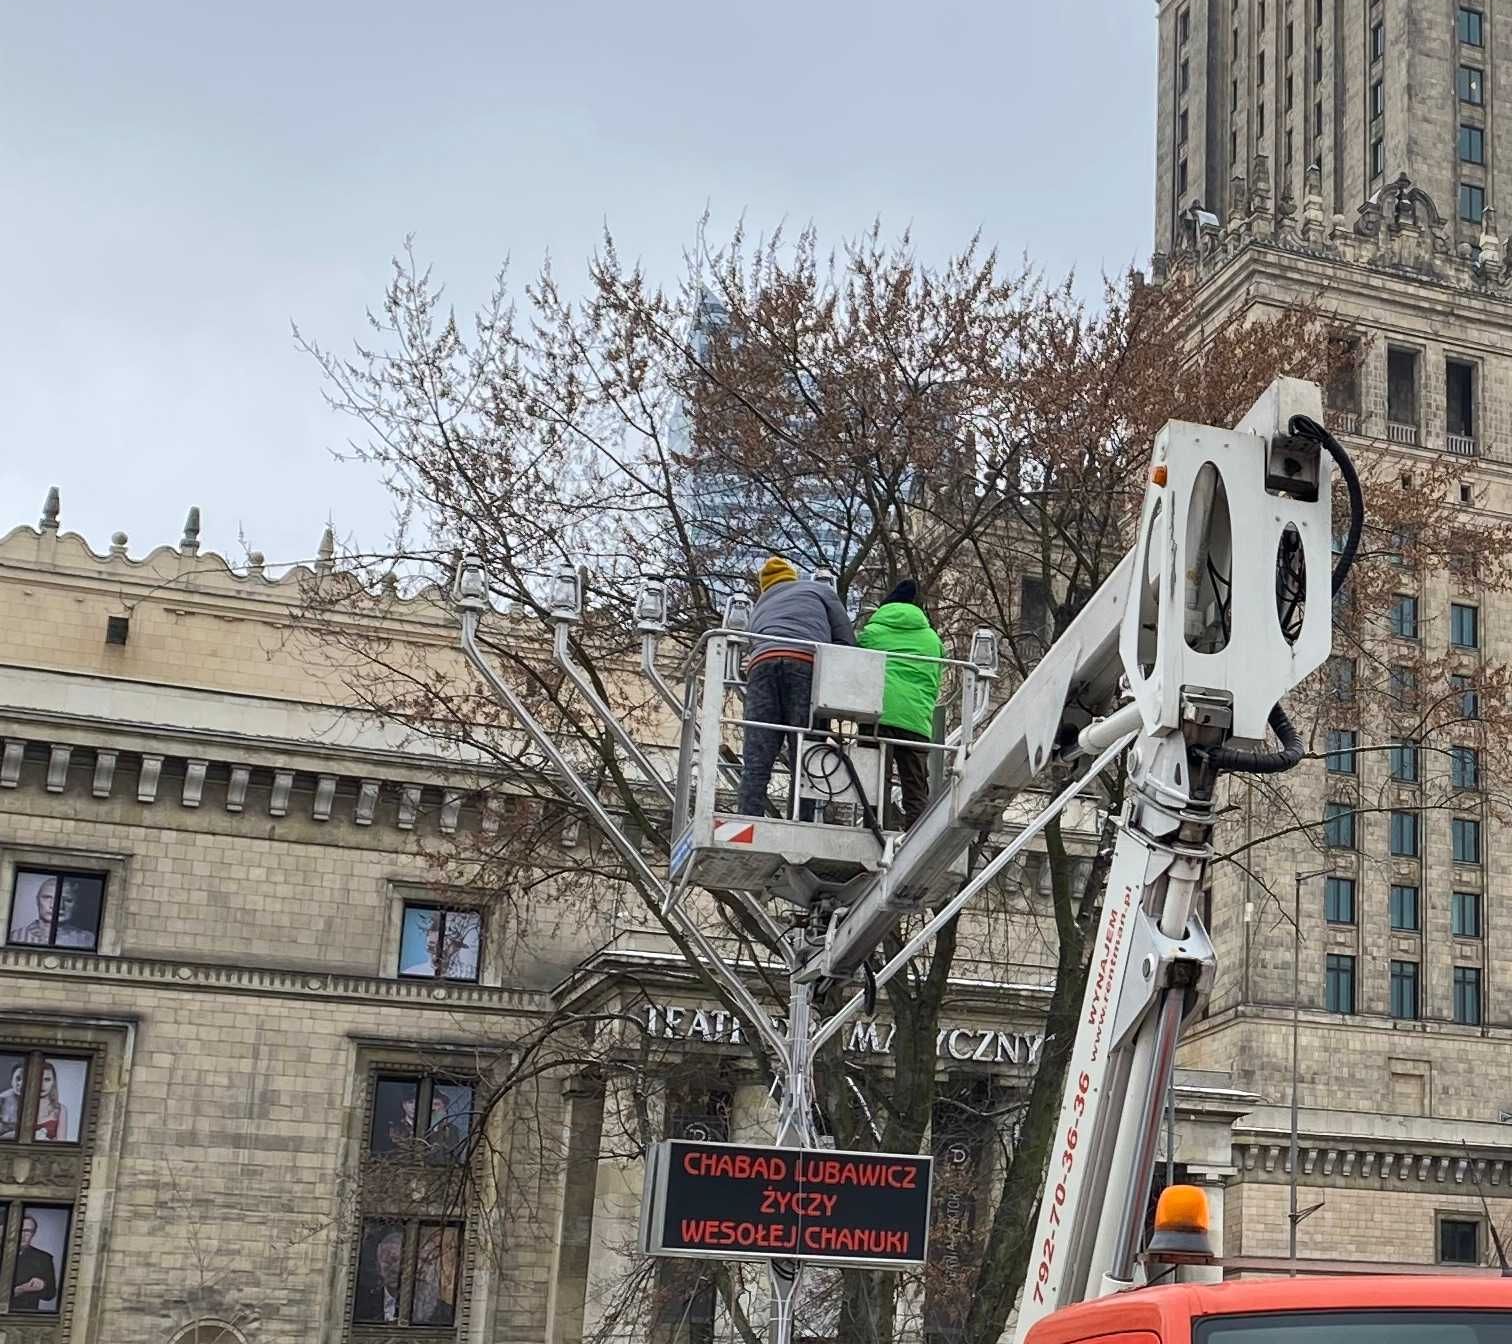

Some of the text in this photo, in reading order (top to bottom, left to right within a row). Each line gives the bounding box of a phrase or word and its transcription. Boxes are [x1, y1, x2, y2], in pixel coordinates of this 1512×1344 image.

[1088, 909, 1118, 1025] WYNAJEM
[1091, 885, 1132, 1062] www.rentman.pl
[683, 1152, 918, 1189] CHABAD LUBAWICZ
[759, 1185, 838, 1217] ŻYCZY
[1033, 1071, 1090, 1305] 792-70-36-36
[681, 1219, 909, 1254] WESOŁEJ CHANUKI
